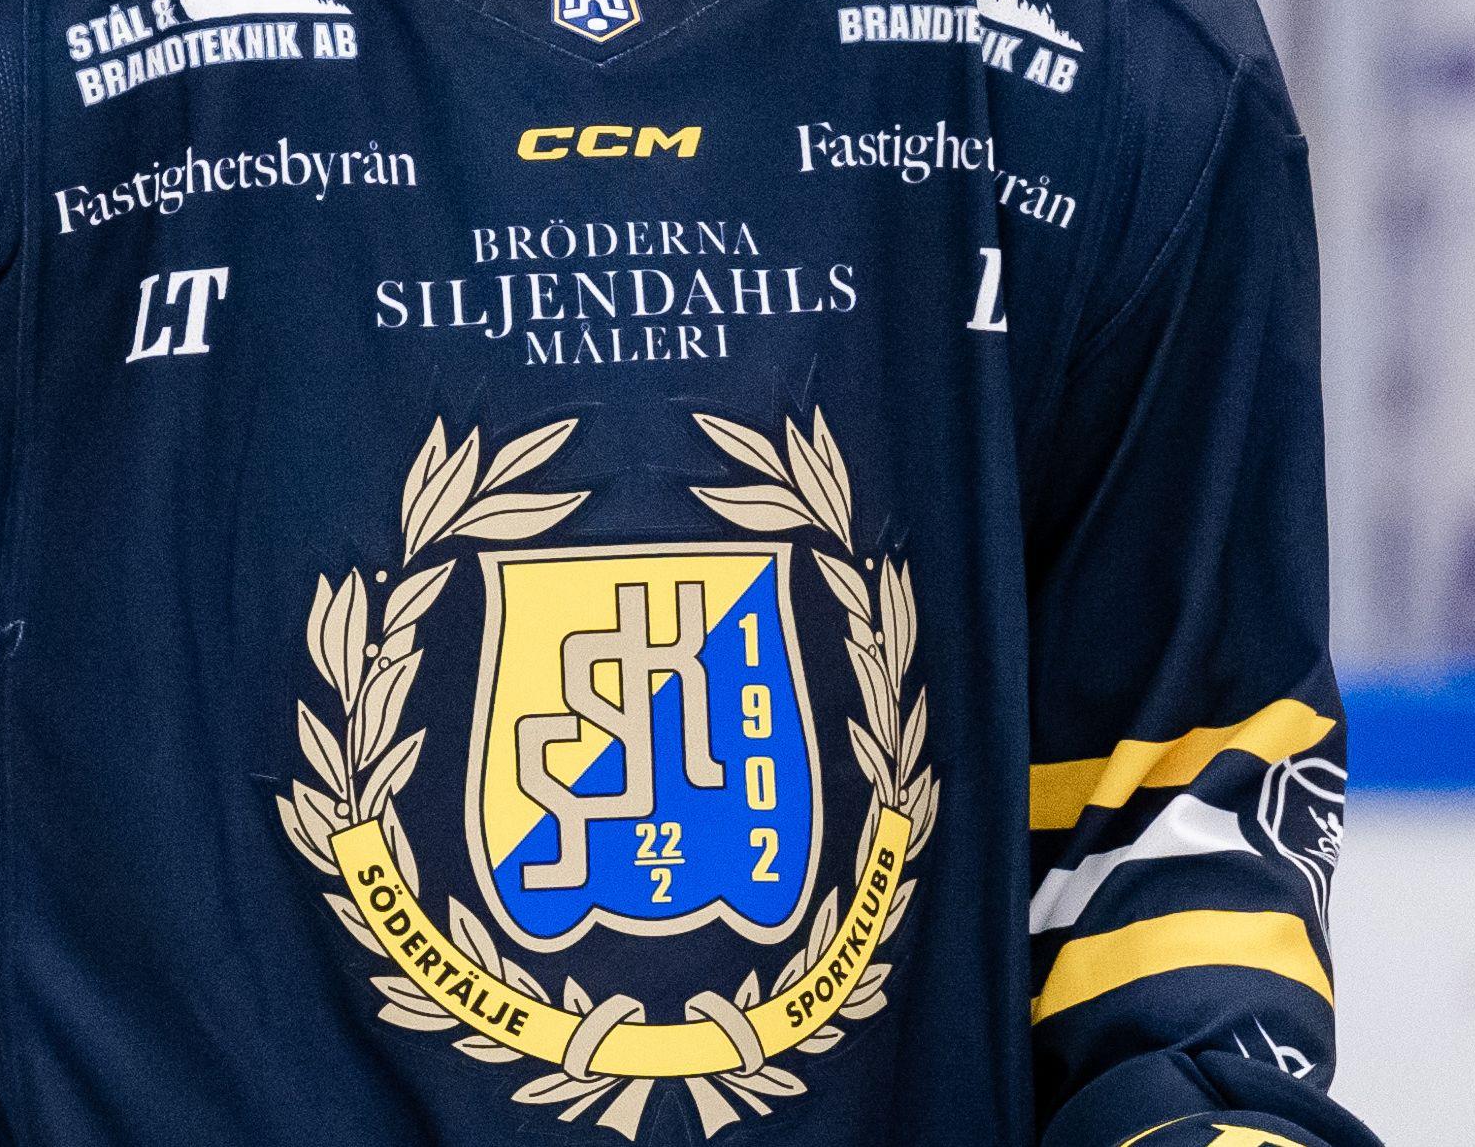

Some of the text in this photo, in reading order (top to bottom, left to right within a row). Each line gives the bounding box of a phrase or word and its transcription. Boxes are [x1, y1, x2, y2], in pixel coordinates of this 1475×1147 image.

[66, 3, 153, 61] STÅL
[75, 21, 358, 107] BRANDTEKNIK AB
[1025, 47, 1079, 94] AB
[517, 125, 702, 161] CCM
[54, 137, 417, 234] Fastighetsbyrån
[473, 219, 759, 263] BRÖDERNA
[126, 266, 229, 364] LT
[376, 264, 857, 340] SILJENDAHLS
[526, 324, 728, 366] MÅLERI
[634, 822, 683, 859] 22
[650, 868, 673, 904] 2
[357, 847, 895, 1037] SÖDERTÄLJE SPORTKLUBB
